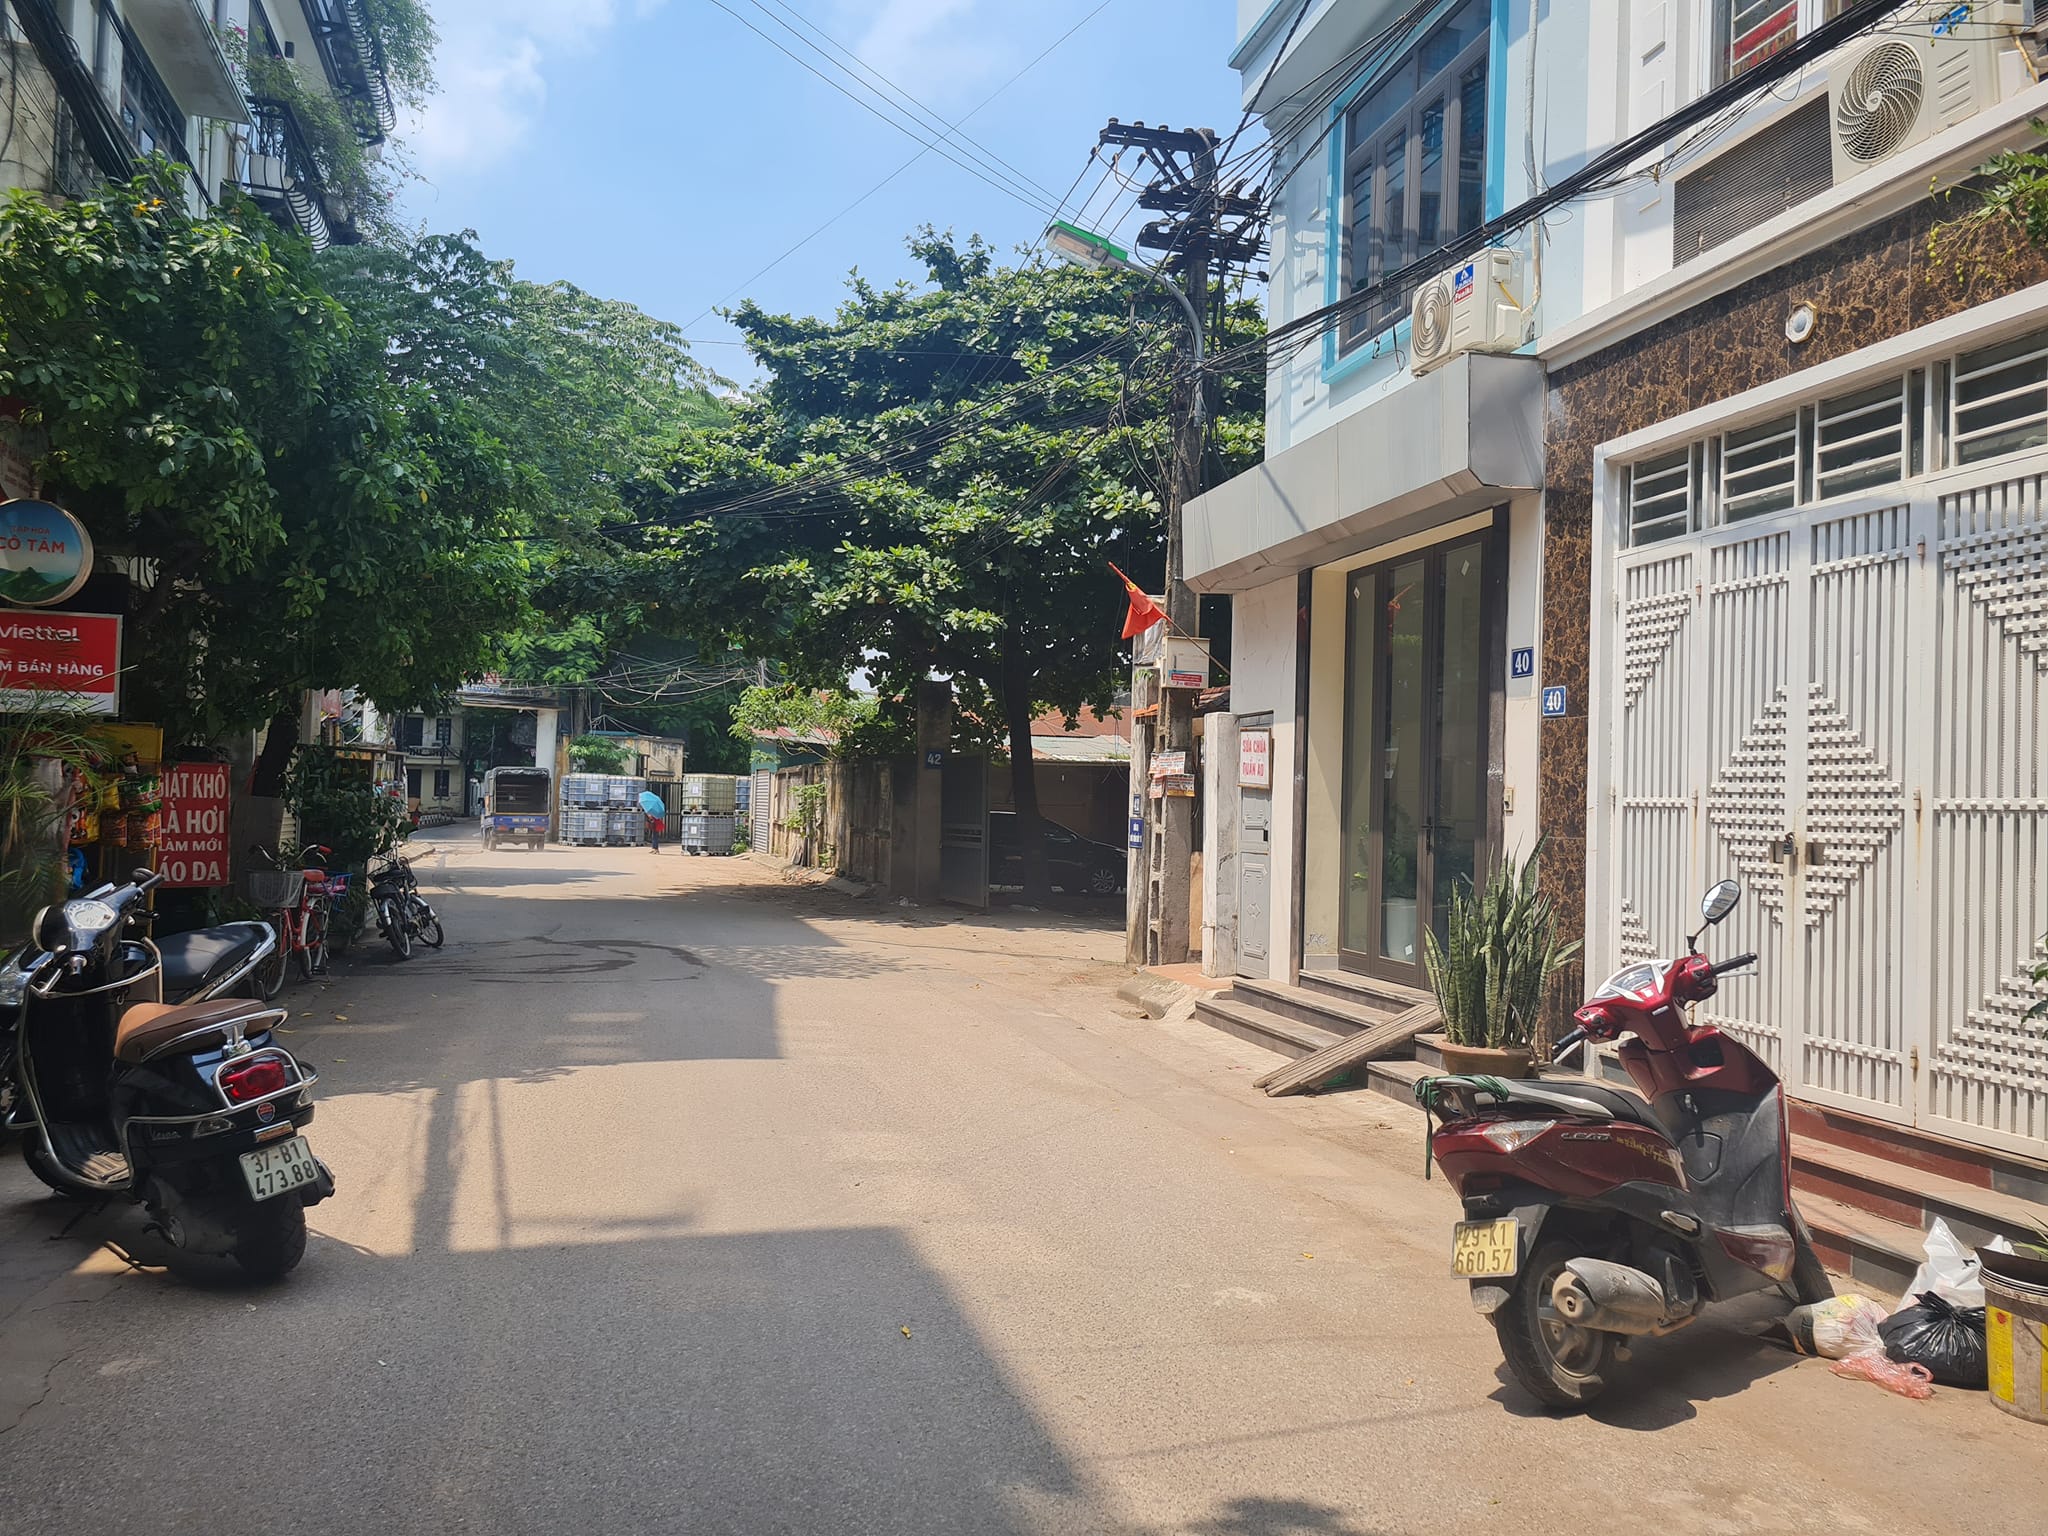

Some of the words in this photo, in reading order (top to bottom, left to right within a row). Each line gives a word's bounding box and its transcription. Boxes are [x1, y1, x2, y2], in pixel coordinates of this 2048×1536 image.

[18, 659, 51, 673] BÁN
[57, 661, 104, 677] HÀNG
[1515, 652, 1529, 673] 40
[1546, 690, 1561, 711] 40
[927, 753, 942, 765] 42
[193, 766, 226, 799] KHÔ
[186, 805, 225, 834] HƠI
[158, 838, 188, 851] LÀM
[193, 837, 222, 851] MỚI
[160, 855, 187, 882] ÁO
[192, 861, 221, 881] DA
[250, 1141, 302, 1173] 37-B1
[255, 1160, 315, 1196] 473.88
[1455, 1248, 1512, 1274] 660.57
